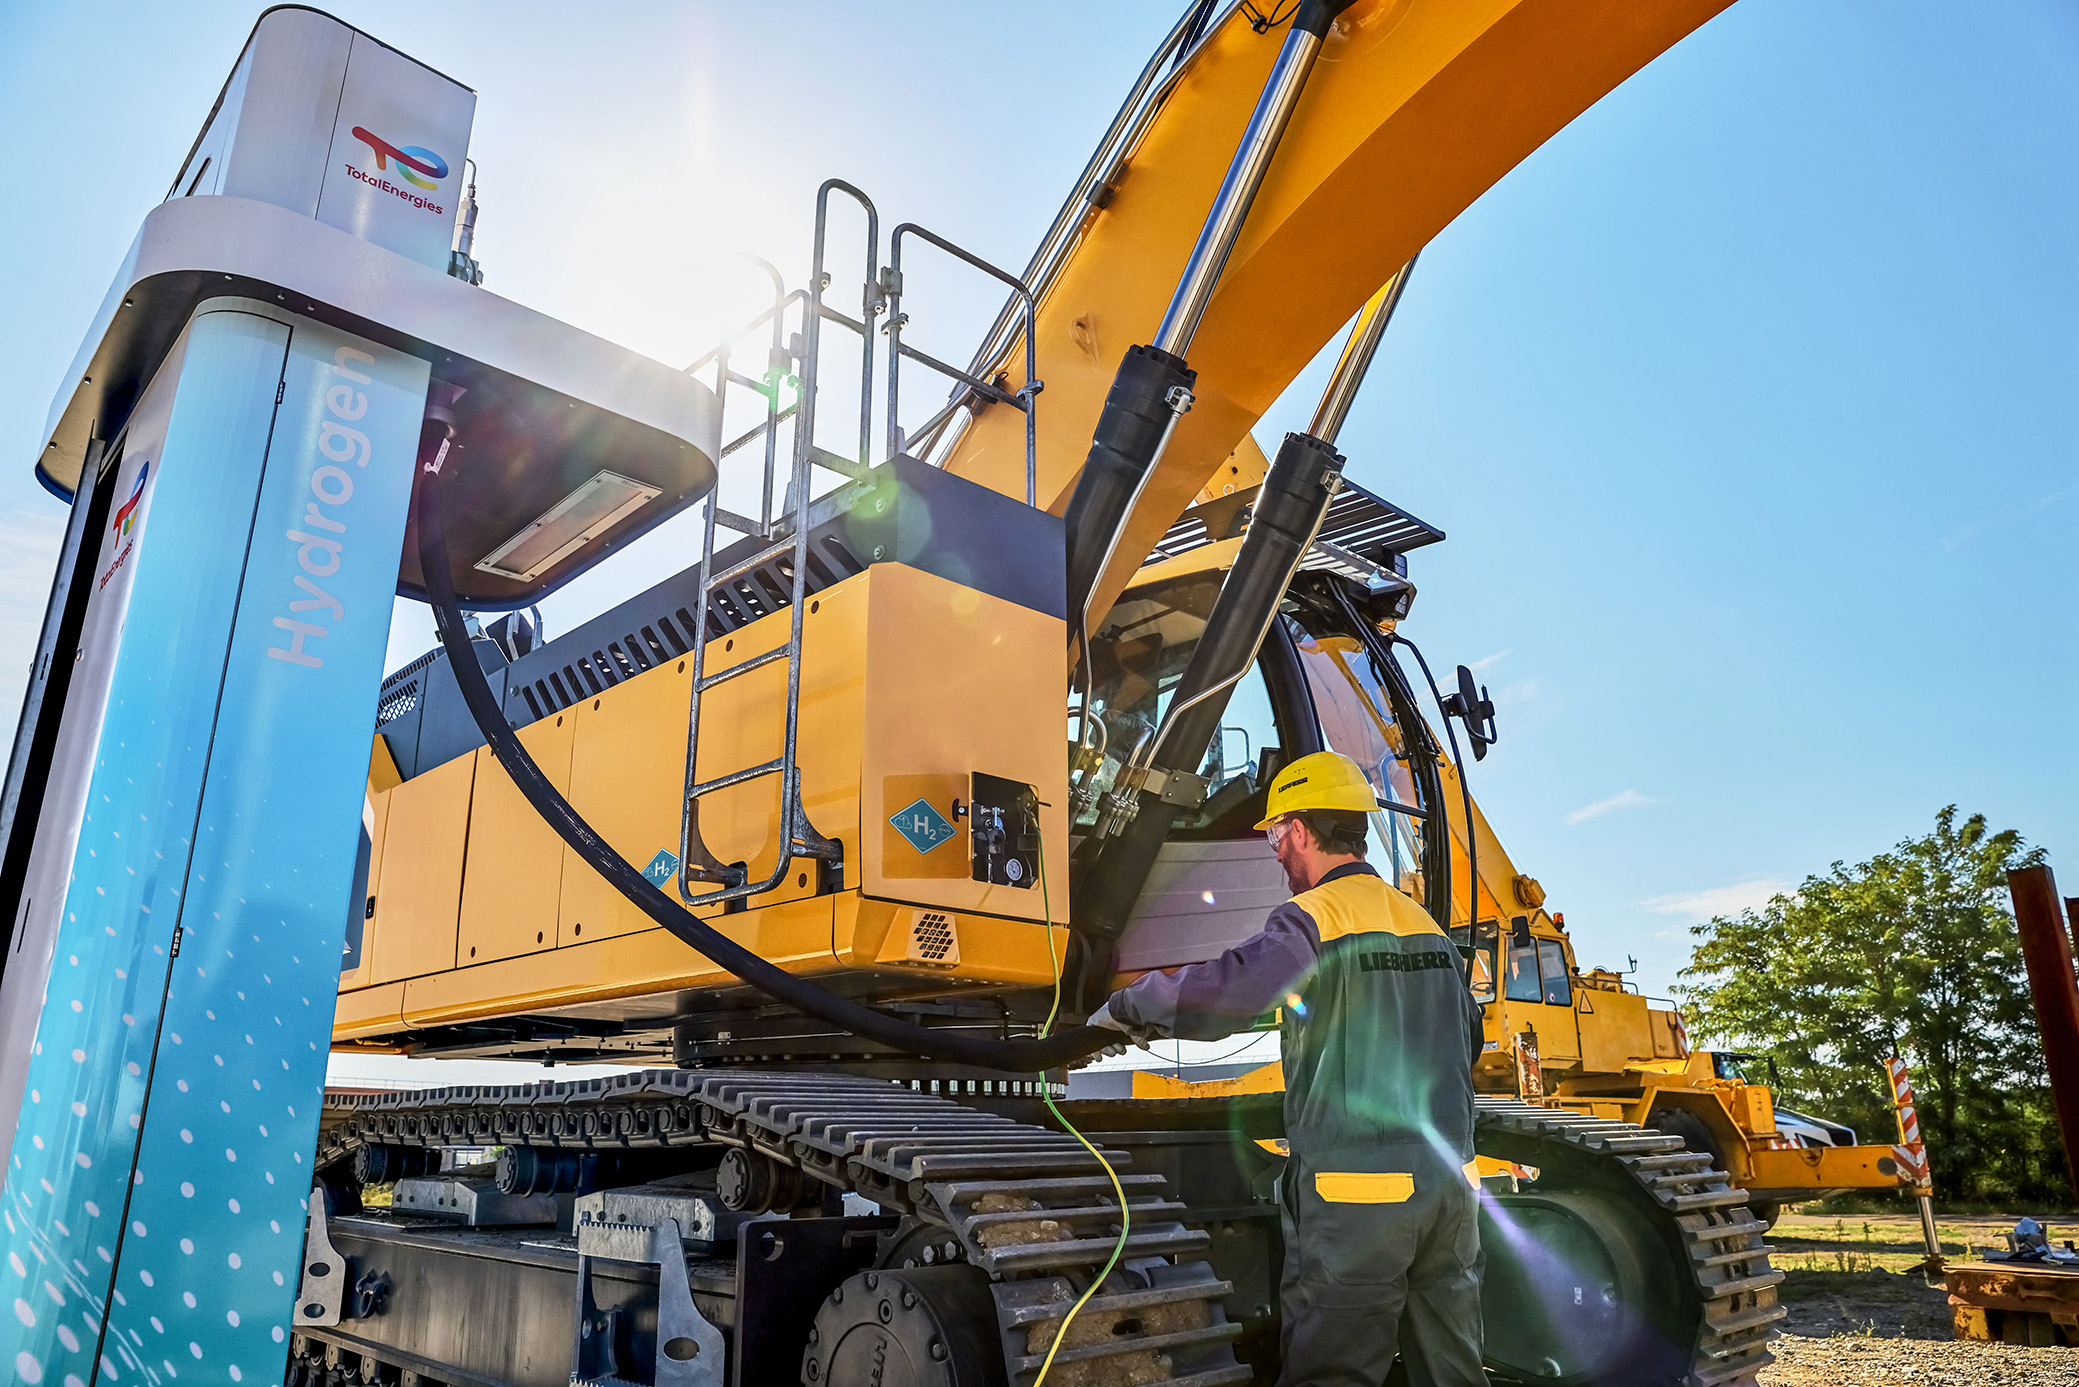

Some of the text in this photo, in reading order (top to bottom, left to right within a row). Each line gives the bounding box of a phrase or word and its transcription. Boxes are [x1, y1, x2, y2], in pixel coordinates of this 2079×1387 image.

[344, 163, 443, 215] TotalEnergies
[267, 346, 376, 669] Hydrogen
[1359, 950, 1455, 973] LIEBHERR
